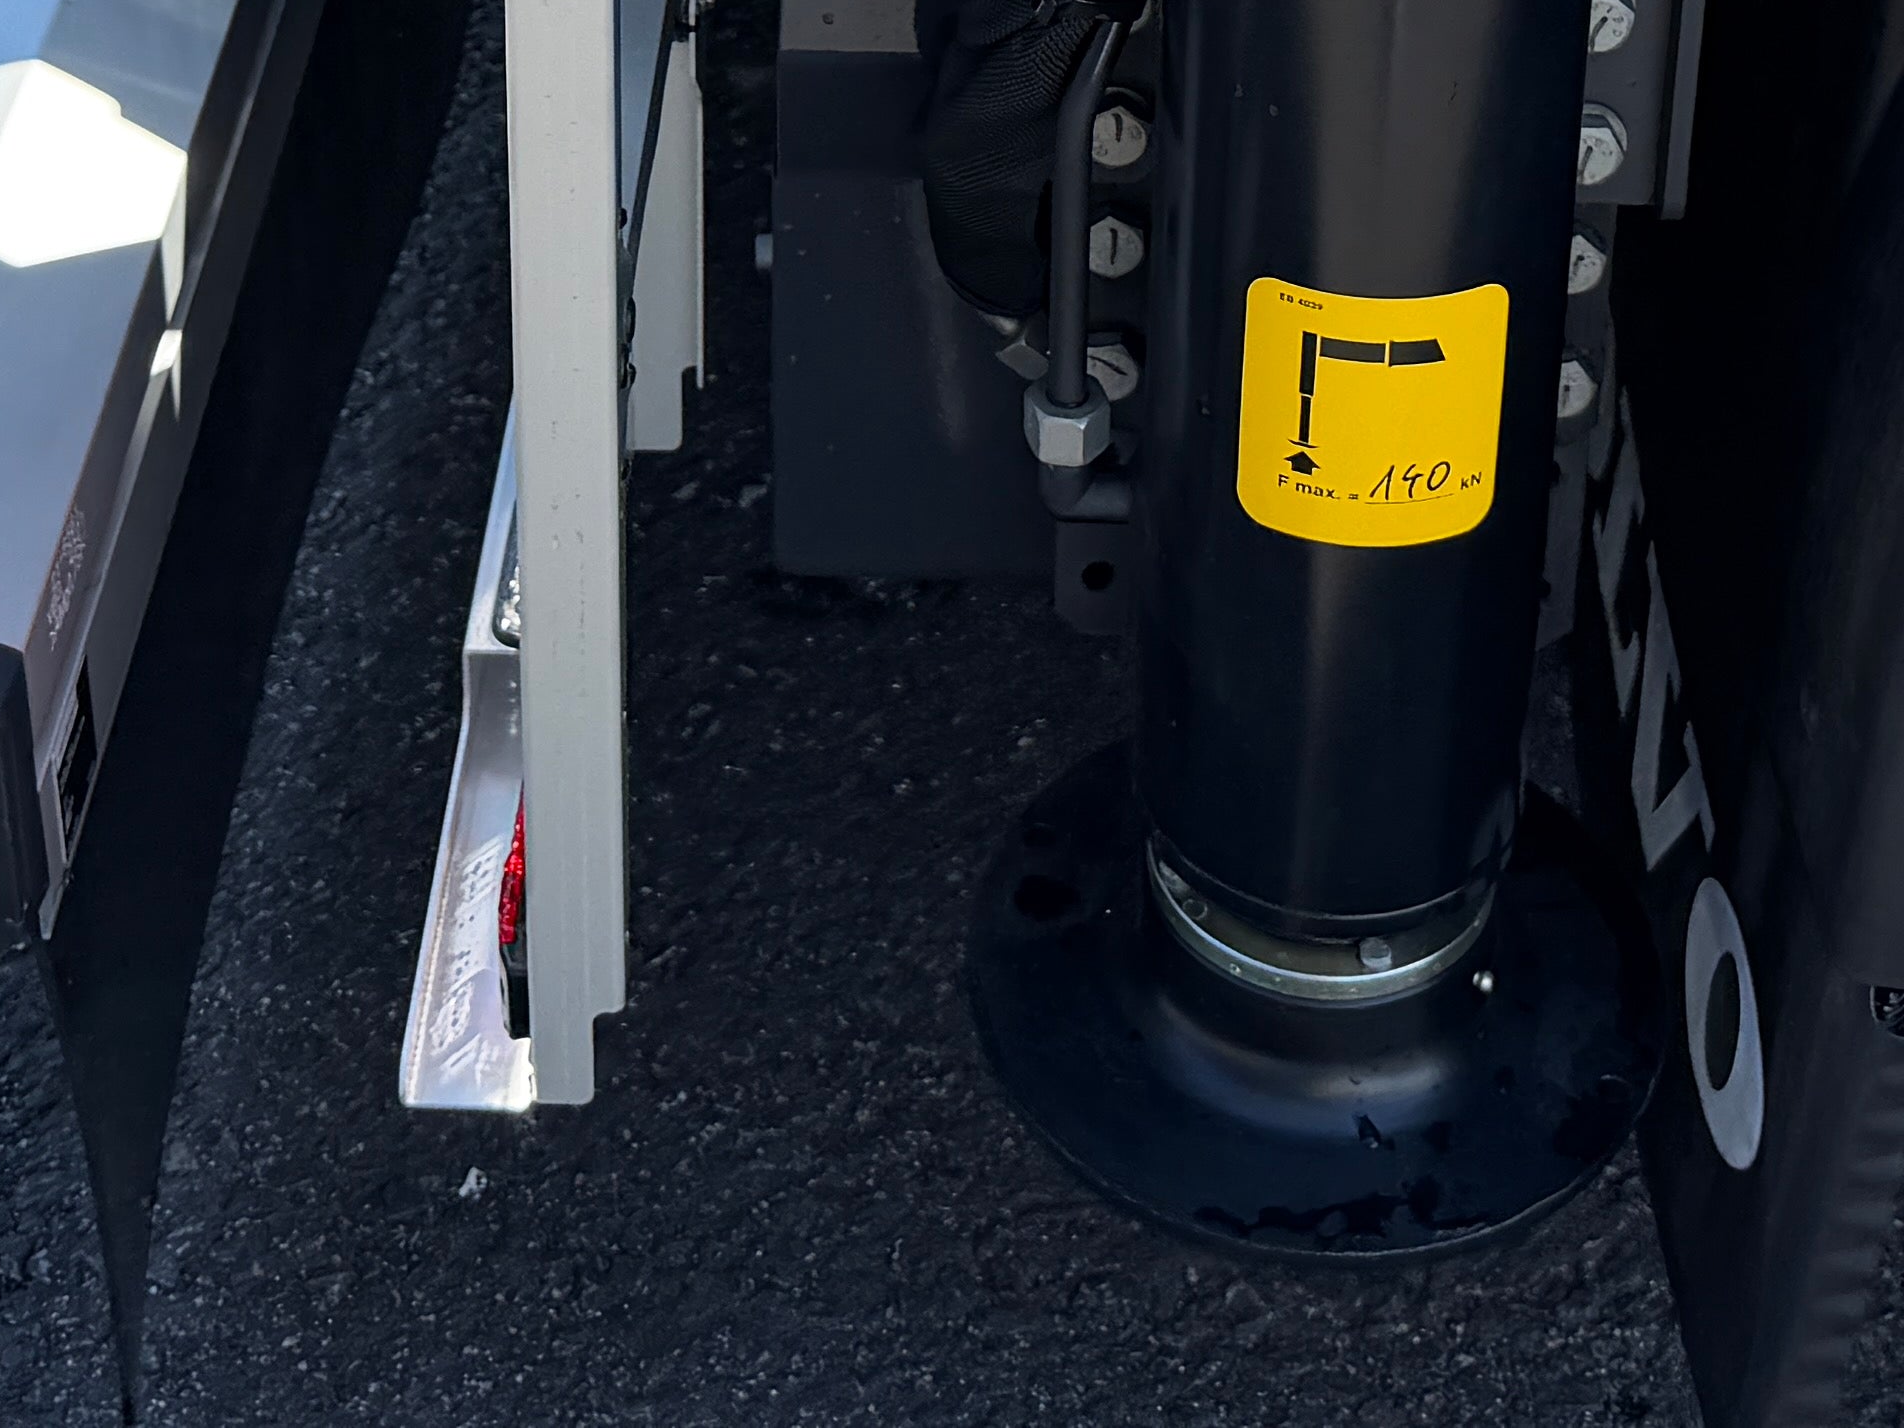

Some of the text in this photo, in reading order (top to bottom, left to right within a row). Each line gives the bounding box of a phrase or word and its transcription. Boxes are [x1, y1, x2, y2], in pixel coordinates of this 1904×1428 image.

[1277, 473, 1290, 488] F
[1295, 482, 1341, 500] max.
[1368, 460, 1451, 501] 140
[1460, 471, 1483, 491] kN
